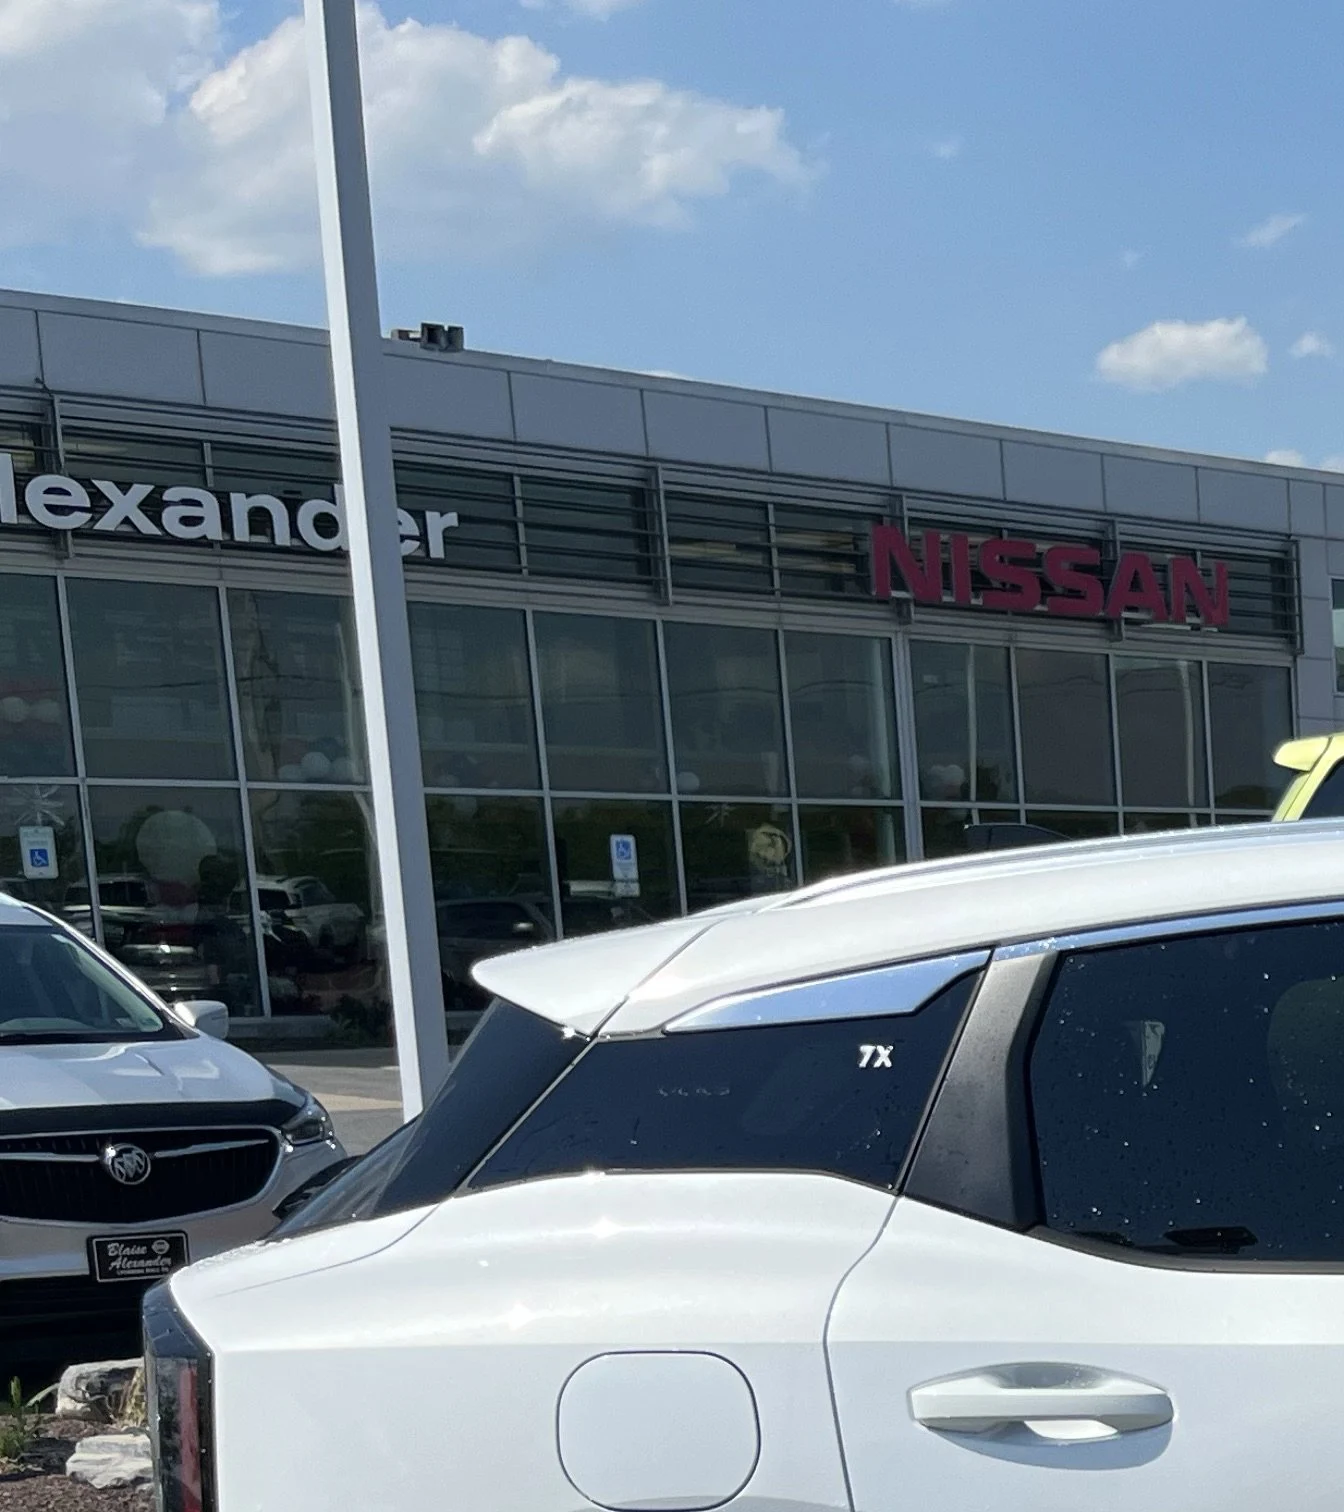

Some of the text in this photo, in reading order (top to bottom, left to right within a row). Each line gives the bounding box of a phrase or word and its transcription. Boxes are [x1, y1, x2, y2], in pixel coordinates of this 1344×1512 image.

[871, 524, 1229, 628] NISSAN
[859, 1044, 894, 1068] 7X
[107, 1241, 148, 1257] Blaise
[108, 1255, 172, 1271] Alexander
